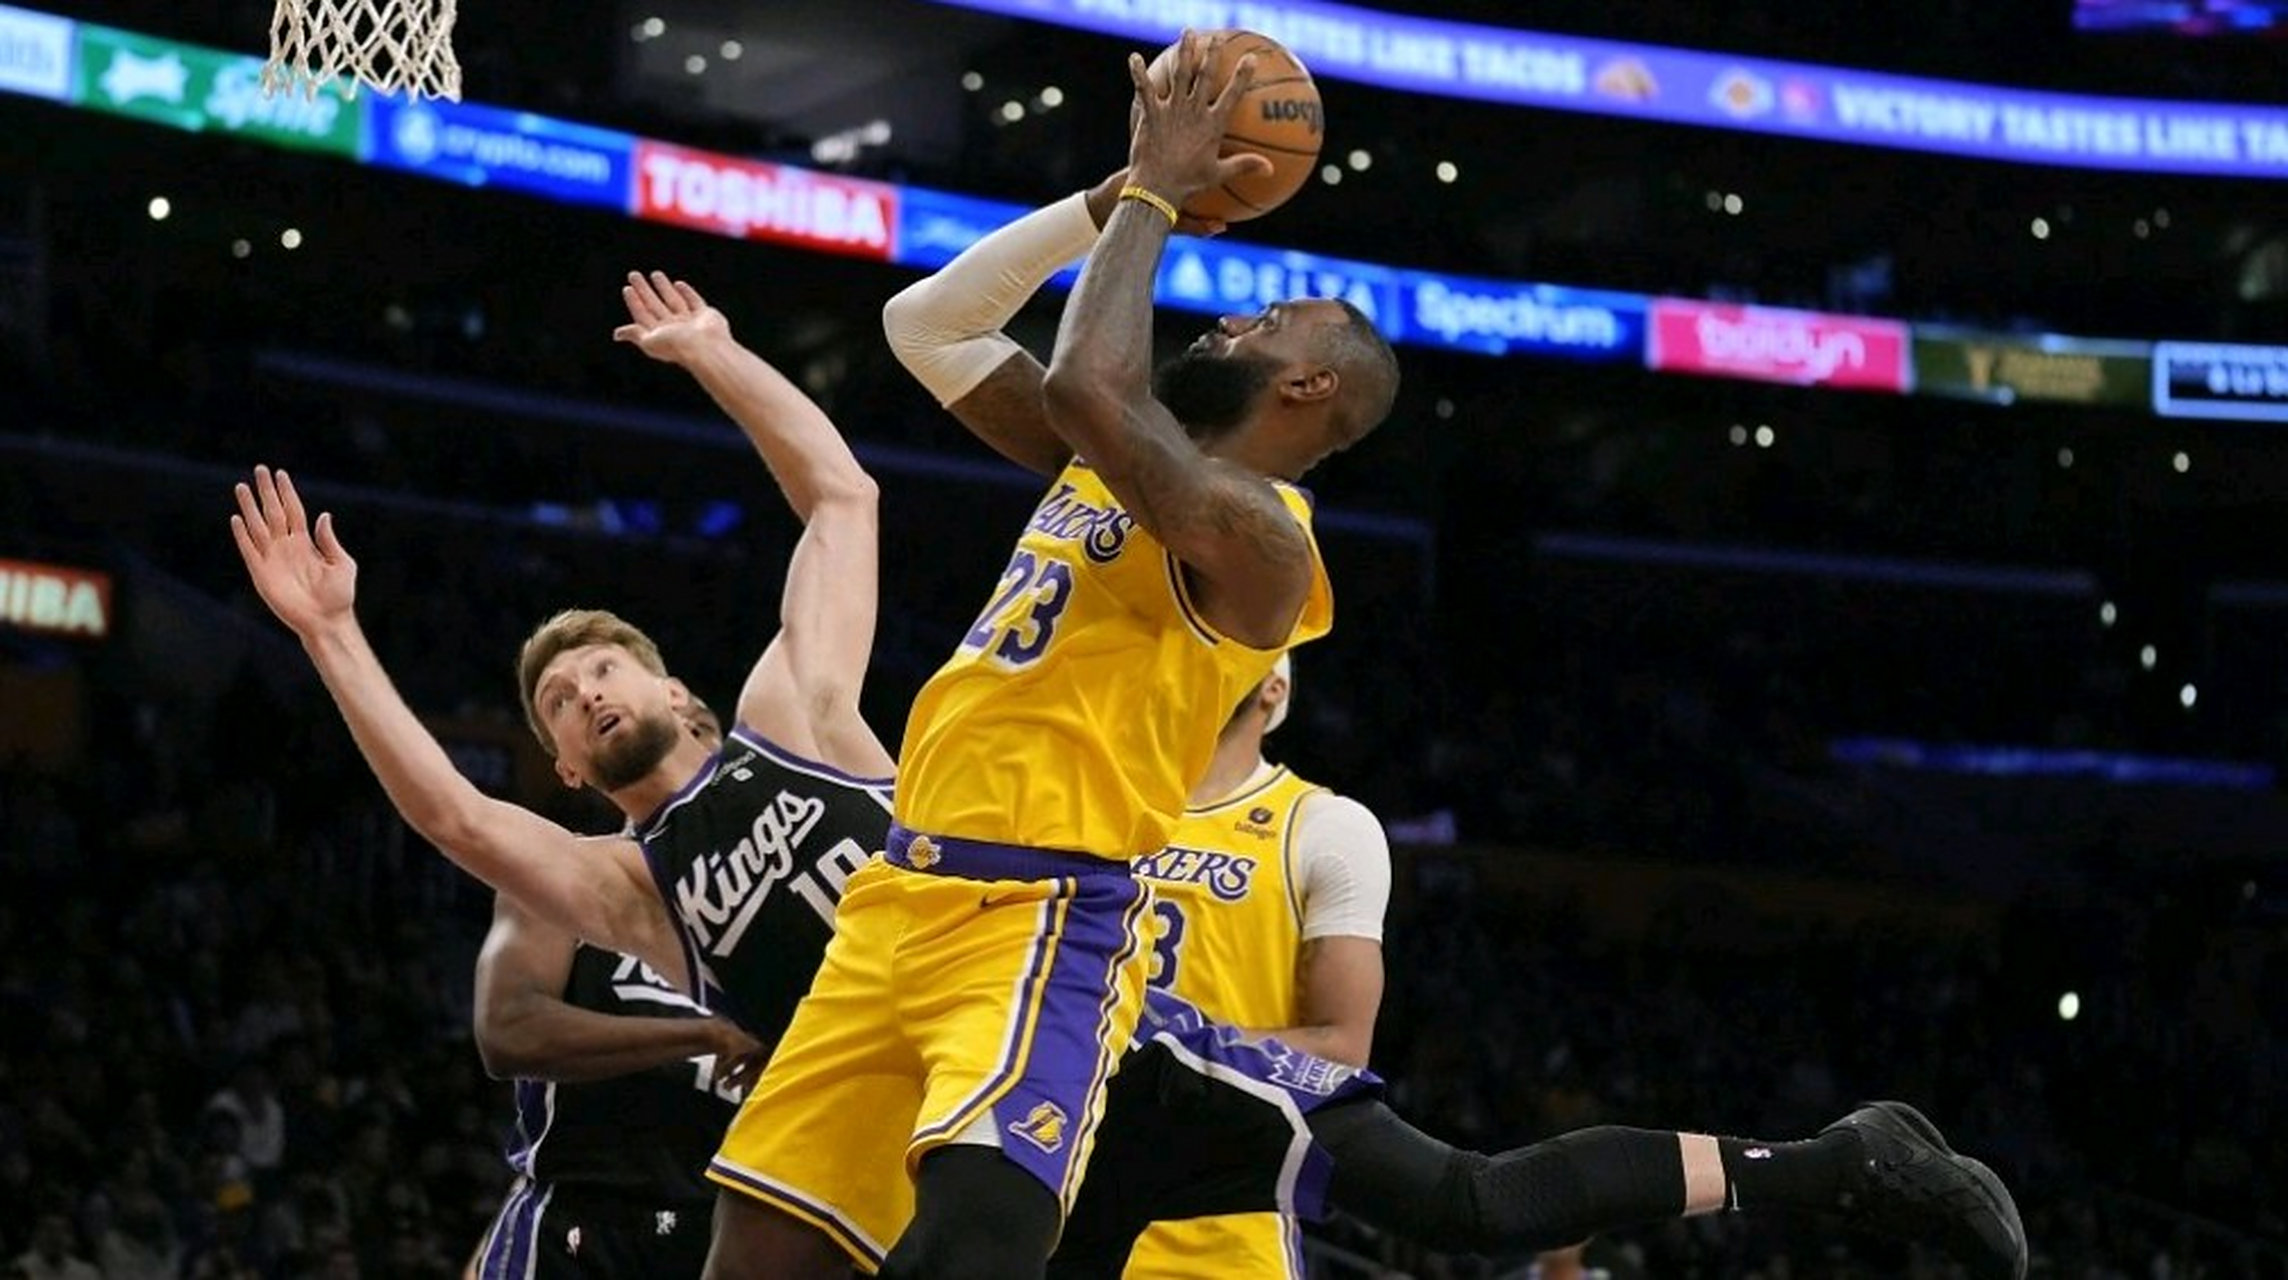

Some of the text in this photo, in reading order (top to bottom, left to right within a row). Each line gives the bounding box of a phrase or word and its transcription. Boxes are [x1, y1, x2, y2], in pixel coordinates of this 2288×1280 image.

[1832, 81, 1994, 142] VICTORY
[2002, 102, 2139, 155] TASTES
[2145, 115, 2237, 160] LIKE
[643, 153, 887, 246] TOSHIBA
[1415, 281, 1616, 349] Spectrum
[963, 550, 1072, 666] 23
[675, 789, 825, 957] Kings
